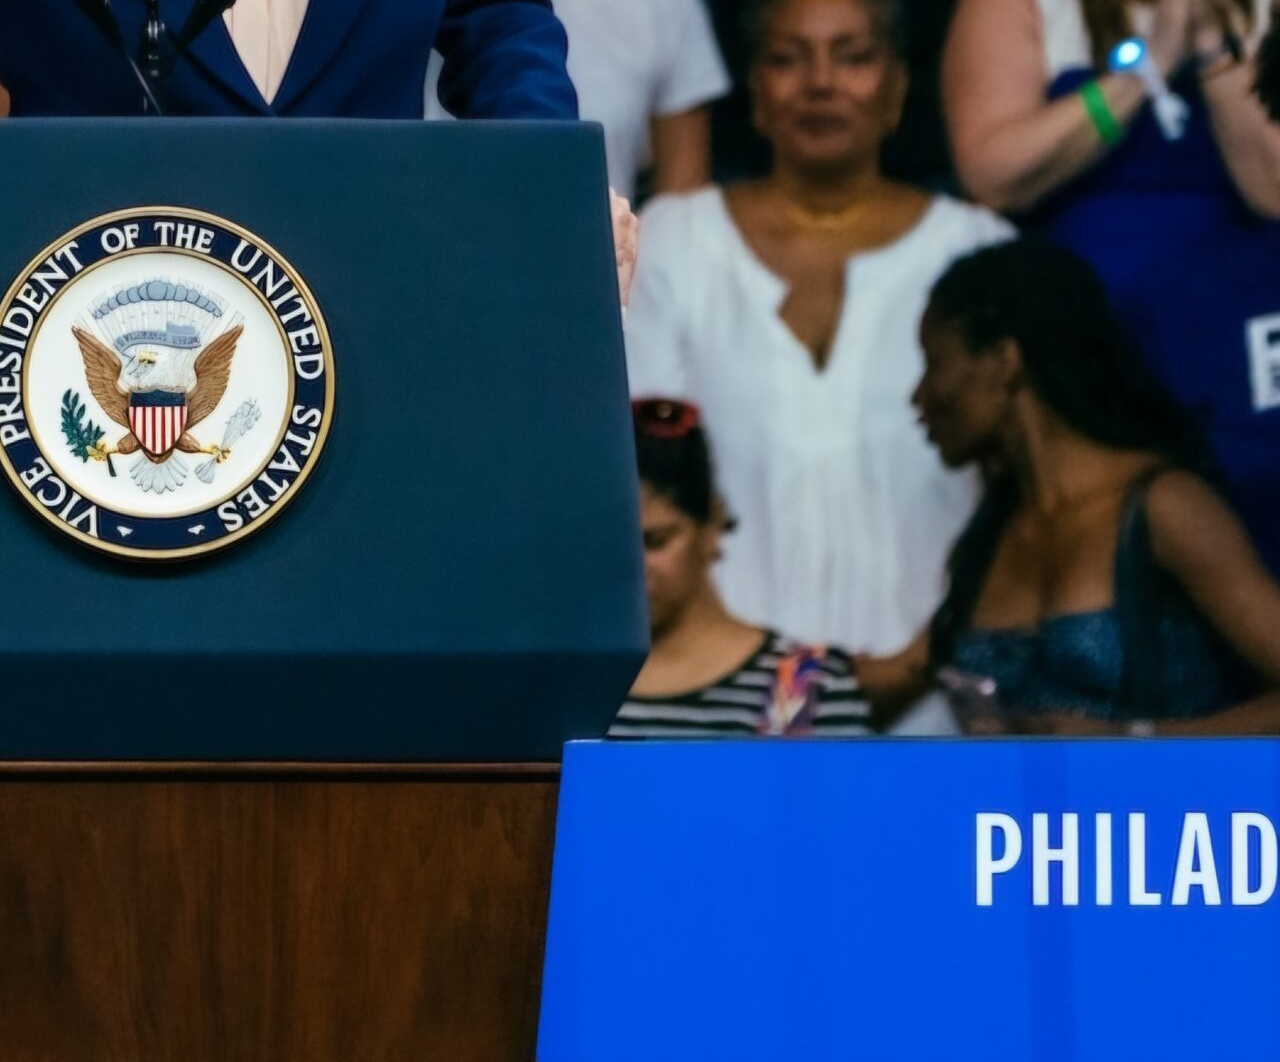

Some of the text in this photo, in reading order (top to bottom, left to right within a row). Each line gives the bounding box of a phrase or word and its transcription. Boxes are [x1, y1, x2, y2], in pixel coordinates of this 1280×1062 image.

[101, 224, 140, 254] OF
[154, 221, 215, 254] THE
[231, 240, 324, 380] UNITED
[20, 457, 99, 538] VICE
[218, 405, 321, 532] STATES
[975, 811, 1279, 906] PHILAD
